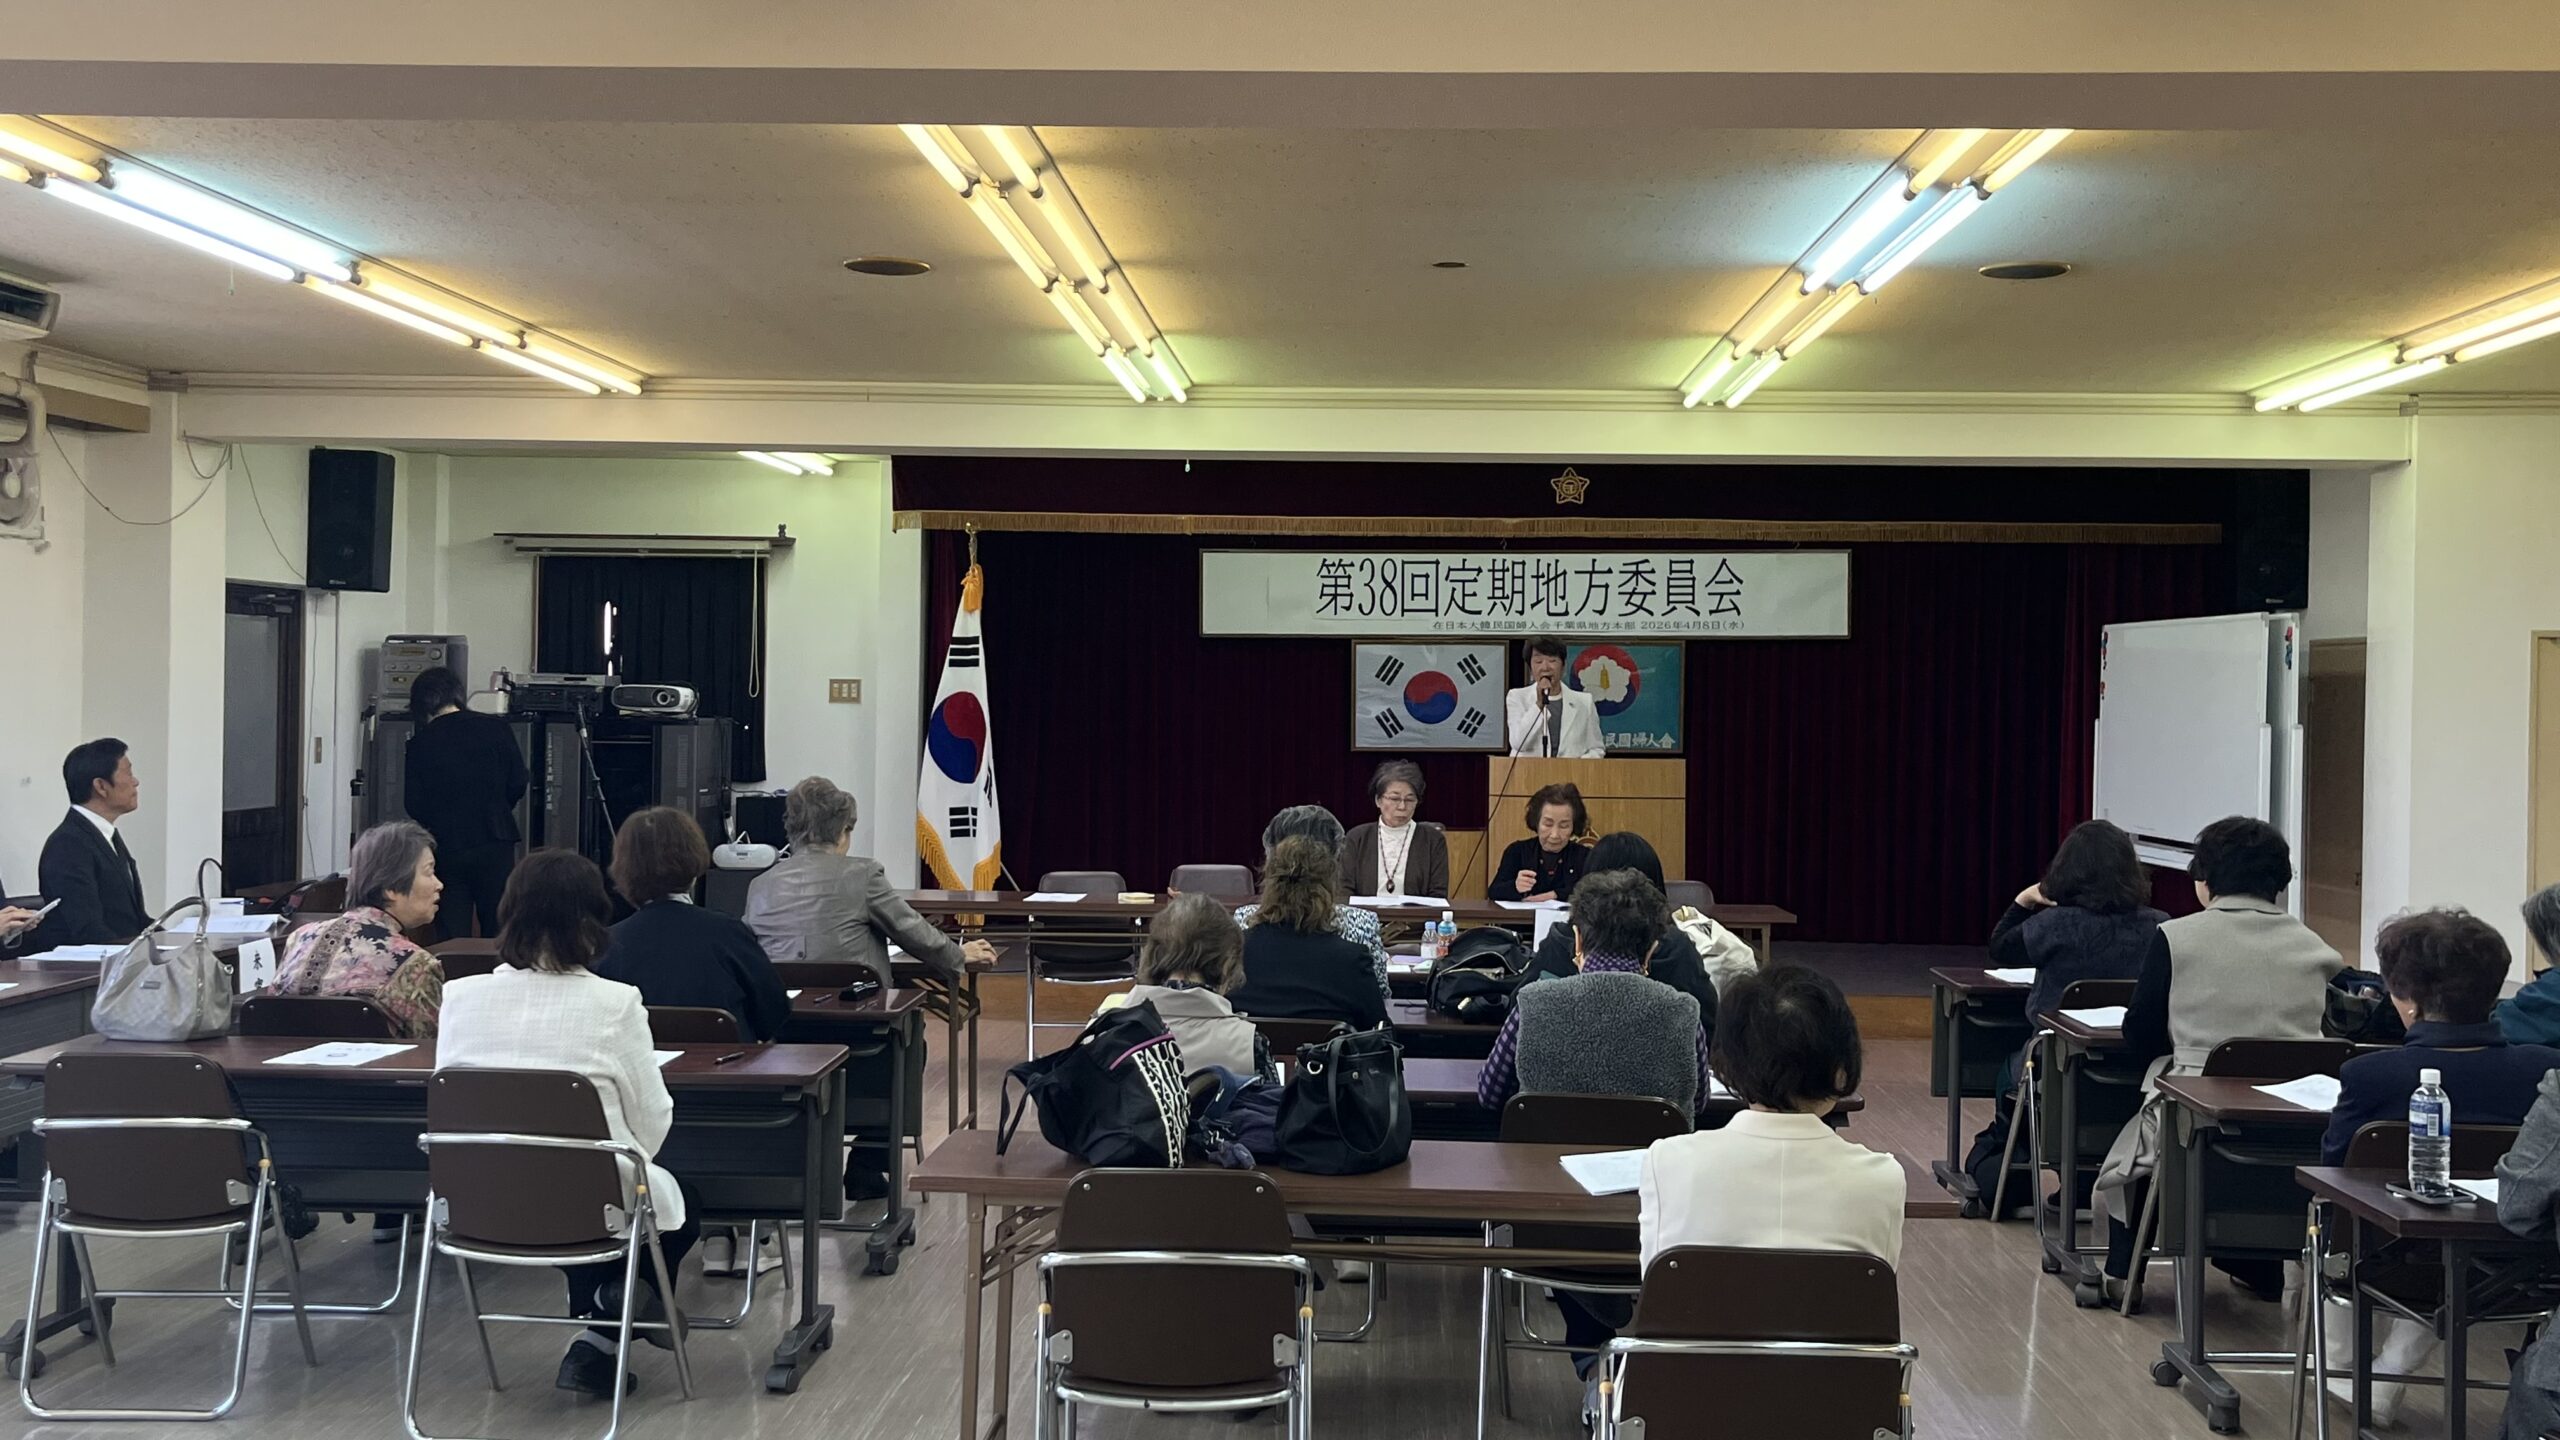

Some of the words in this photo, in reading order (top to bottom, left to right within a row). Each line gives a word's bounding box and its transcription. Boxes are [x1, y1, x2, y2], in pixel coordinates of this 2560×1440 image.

[1315, 557, 1745, 618] 第38回定期地方委員会
